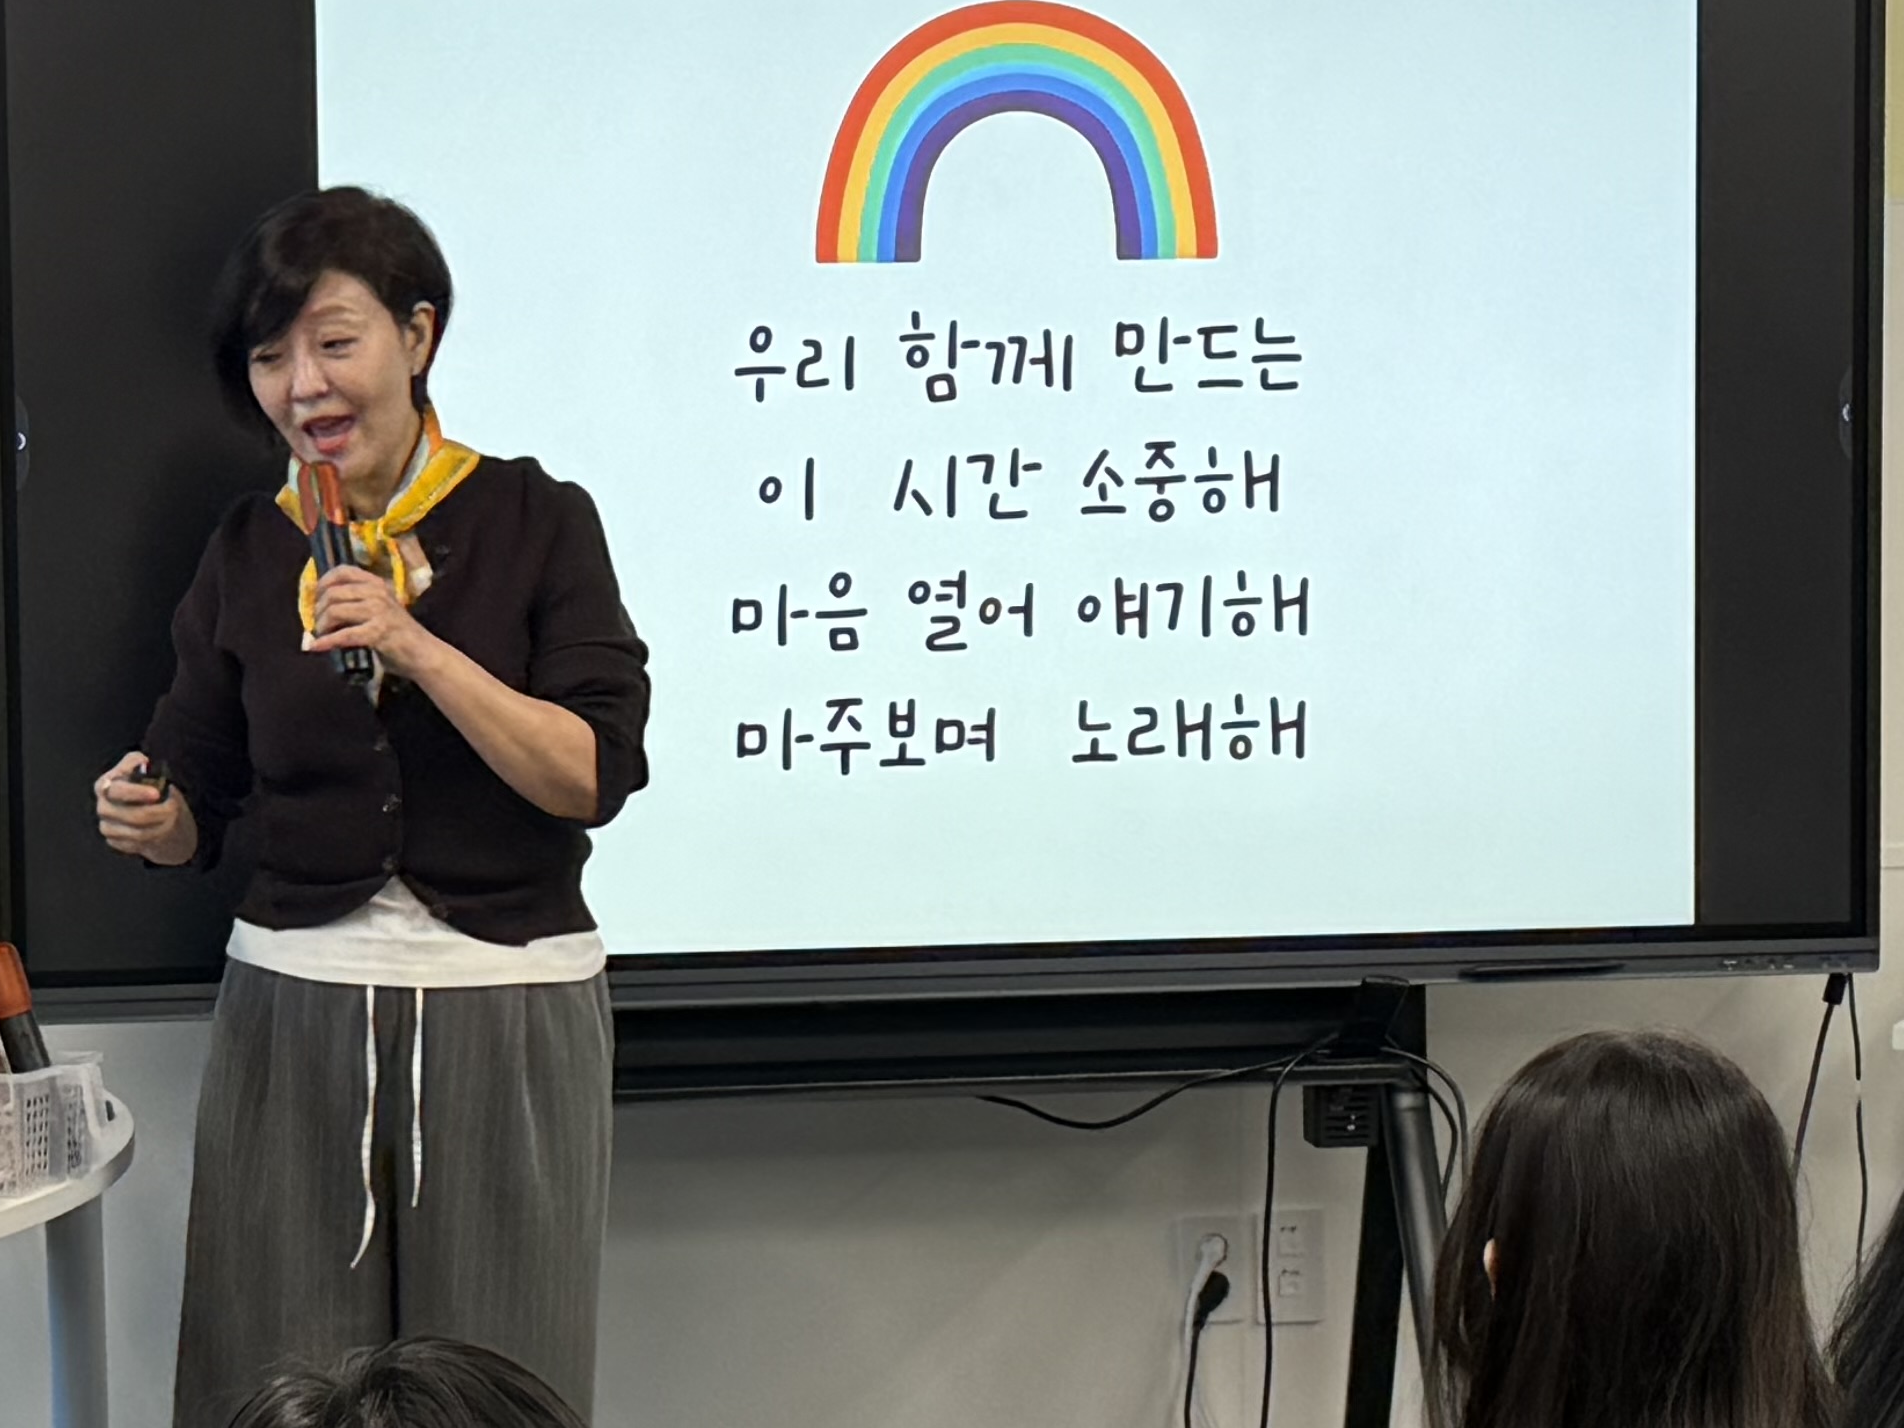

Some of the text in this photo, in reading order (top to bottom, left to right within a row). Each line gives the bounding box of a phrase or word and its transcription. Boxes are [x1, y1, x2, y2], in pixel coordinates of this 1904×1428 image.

[734, 310, 1303, 403] 우리 함께 만드는
[758, 440, 1280, 523] 이 시간 소중해
[732, 569, 1309, 652] 마음 열어 얘기해
[736, 693, 1306, 776] 마주보며 노래해
